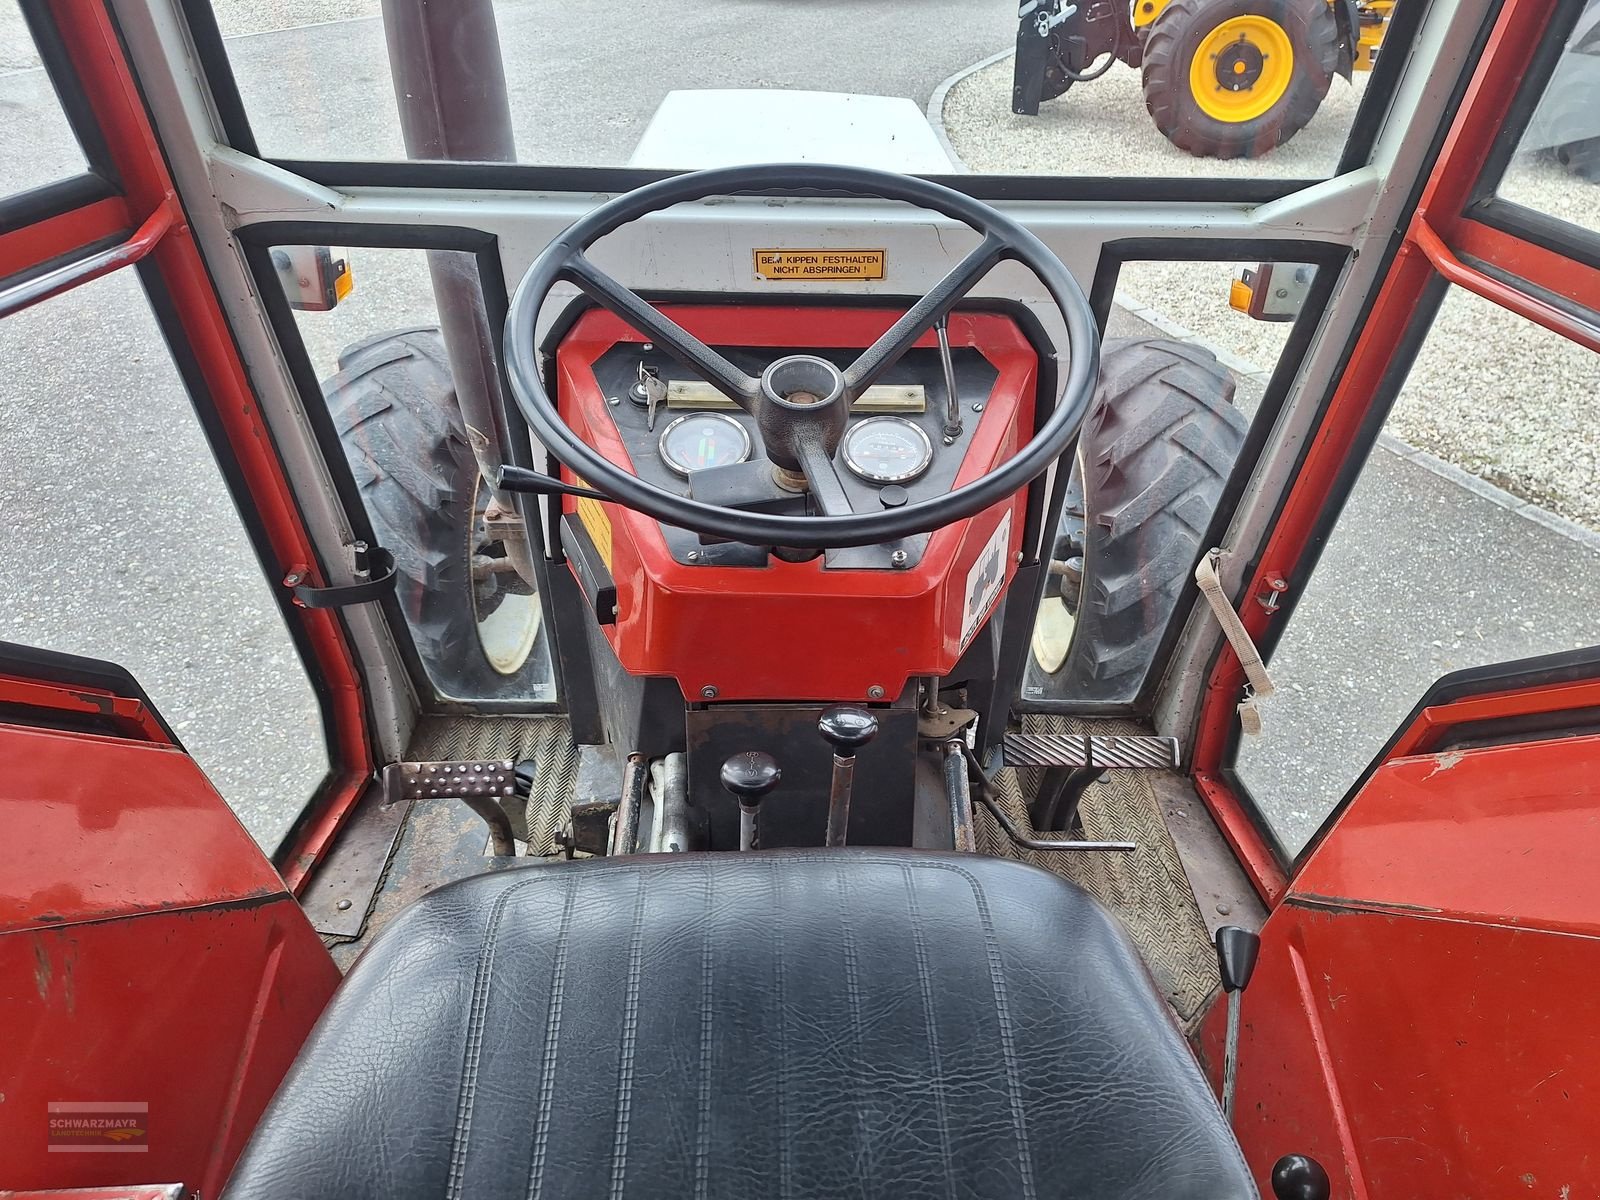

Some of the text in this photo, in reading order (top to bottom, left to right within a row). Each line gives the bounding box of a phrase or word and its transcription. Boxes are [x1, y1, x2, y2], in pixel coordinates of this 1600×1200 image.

[786, 256, 818, 264] KIPPEN
[822, 255, 879, 264] FESTHALTEN
[773, 266, 800, 274] NICHT
[802, 266, 860, 274] ABSPRINGEN
